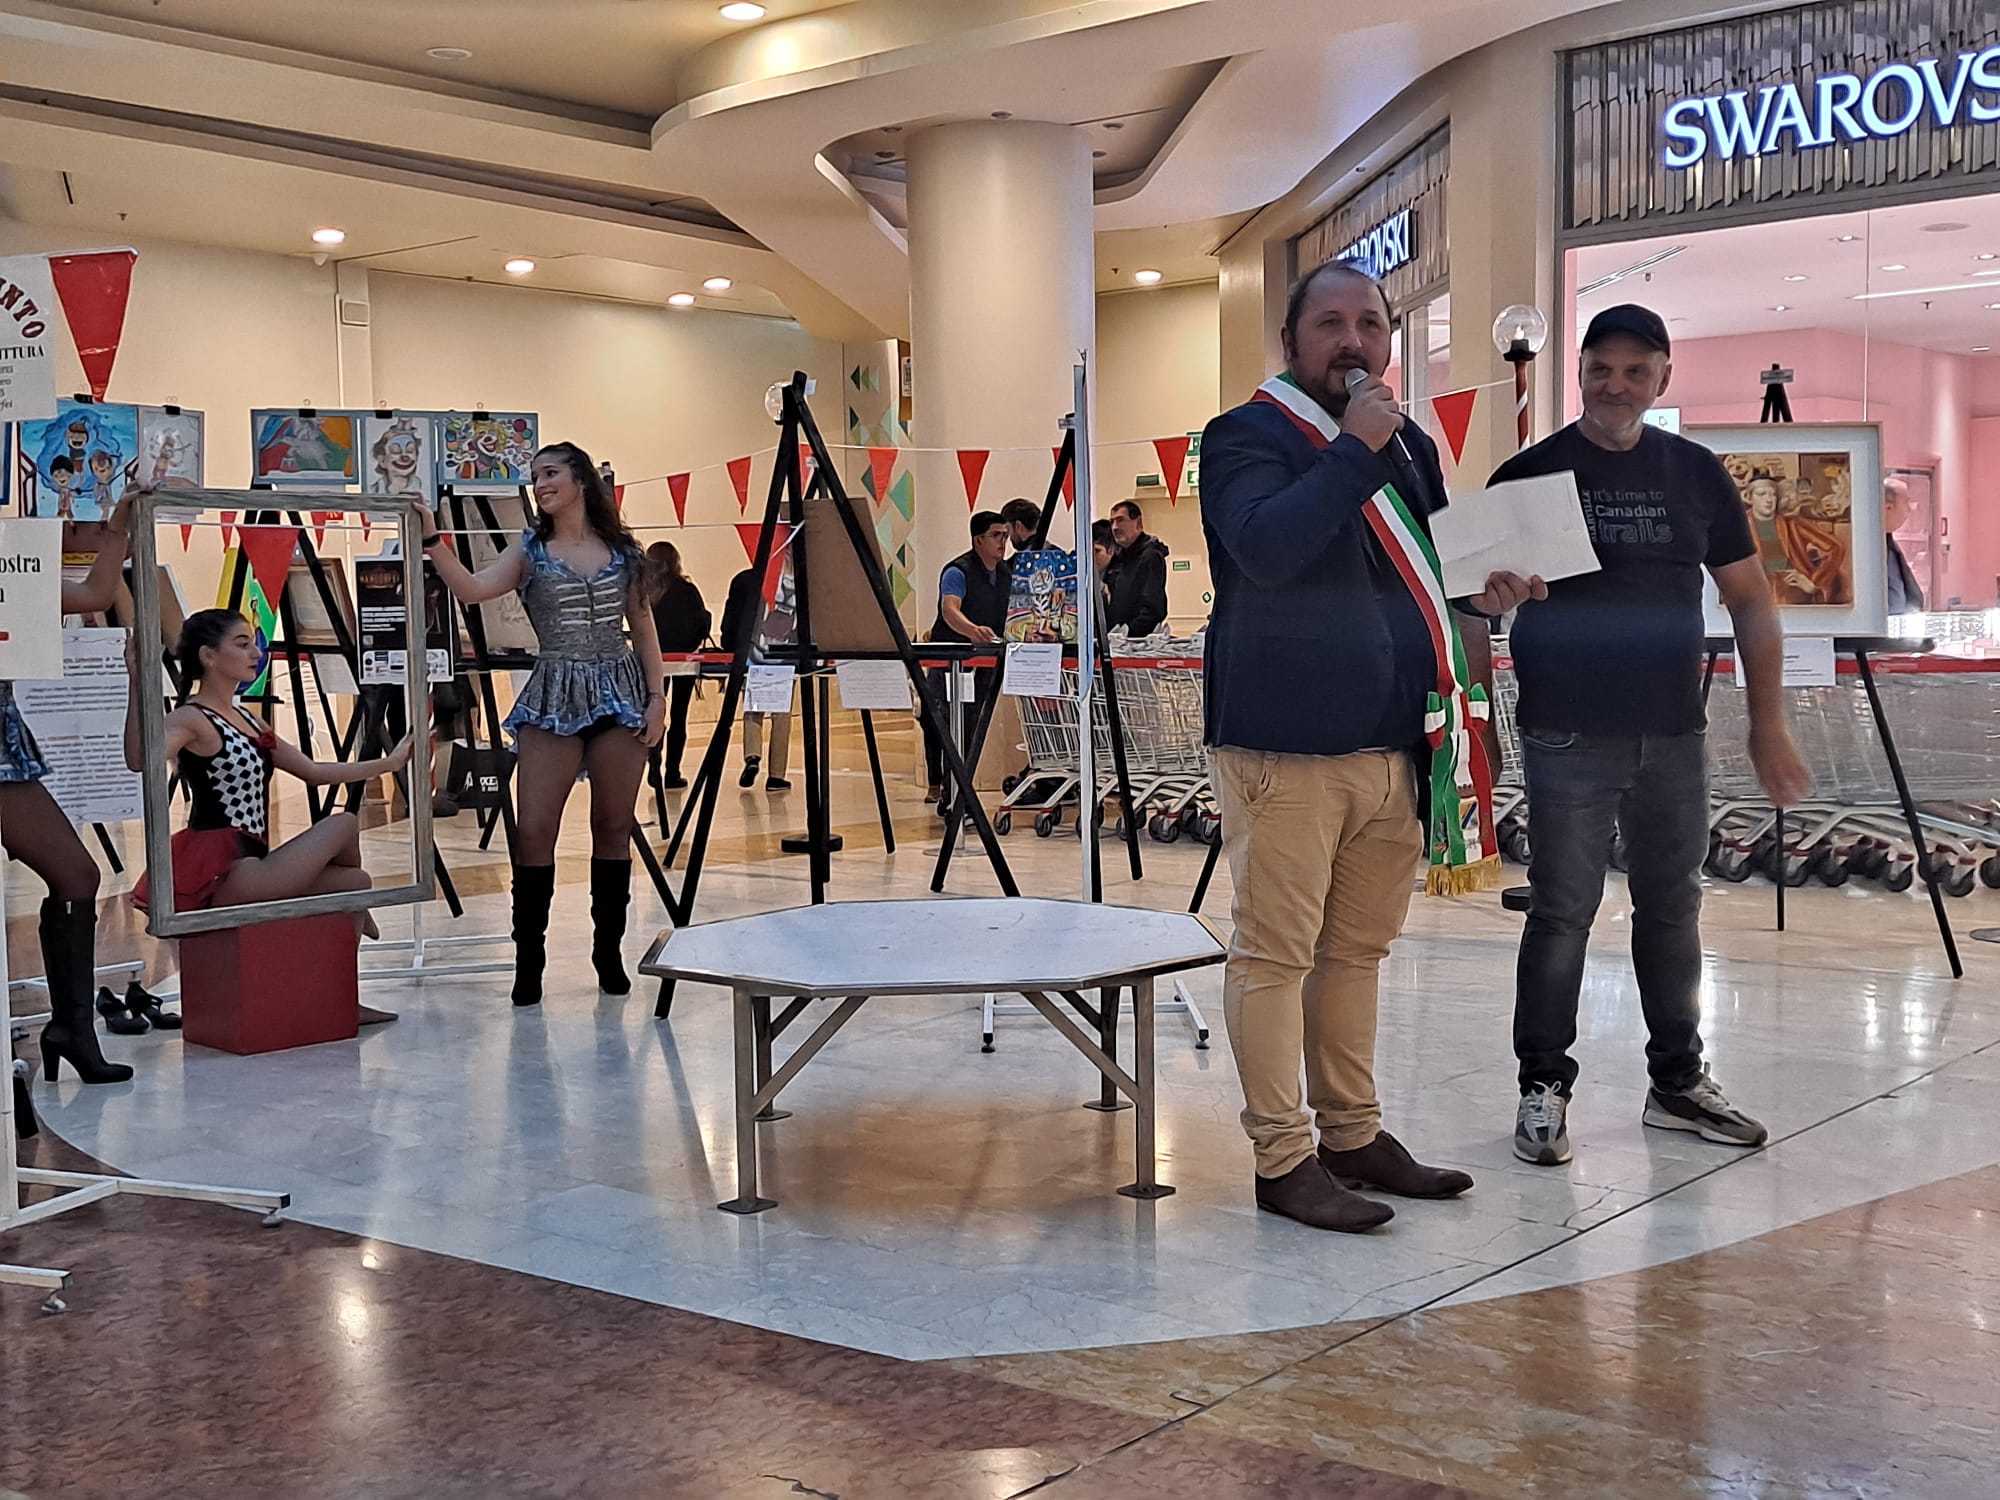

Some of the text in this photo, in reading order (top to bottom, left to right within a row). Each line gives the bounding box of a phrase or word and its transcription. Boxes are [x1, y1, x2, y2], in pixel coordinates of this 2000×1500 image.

[1664, 46, 2000, 168] SWAROVS
[1615, 490, 1646, 501] time
[1649, 489, 1664, 501] to
[1595, 504, 1667, 517] Canadian
[1599, 518, 1673, 543] trails
